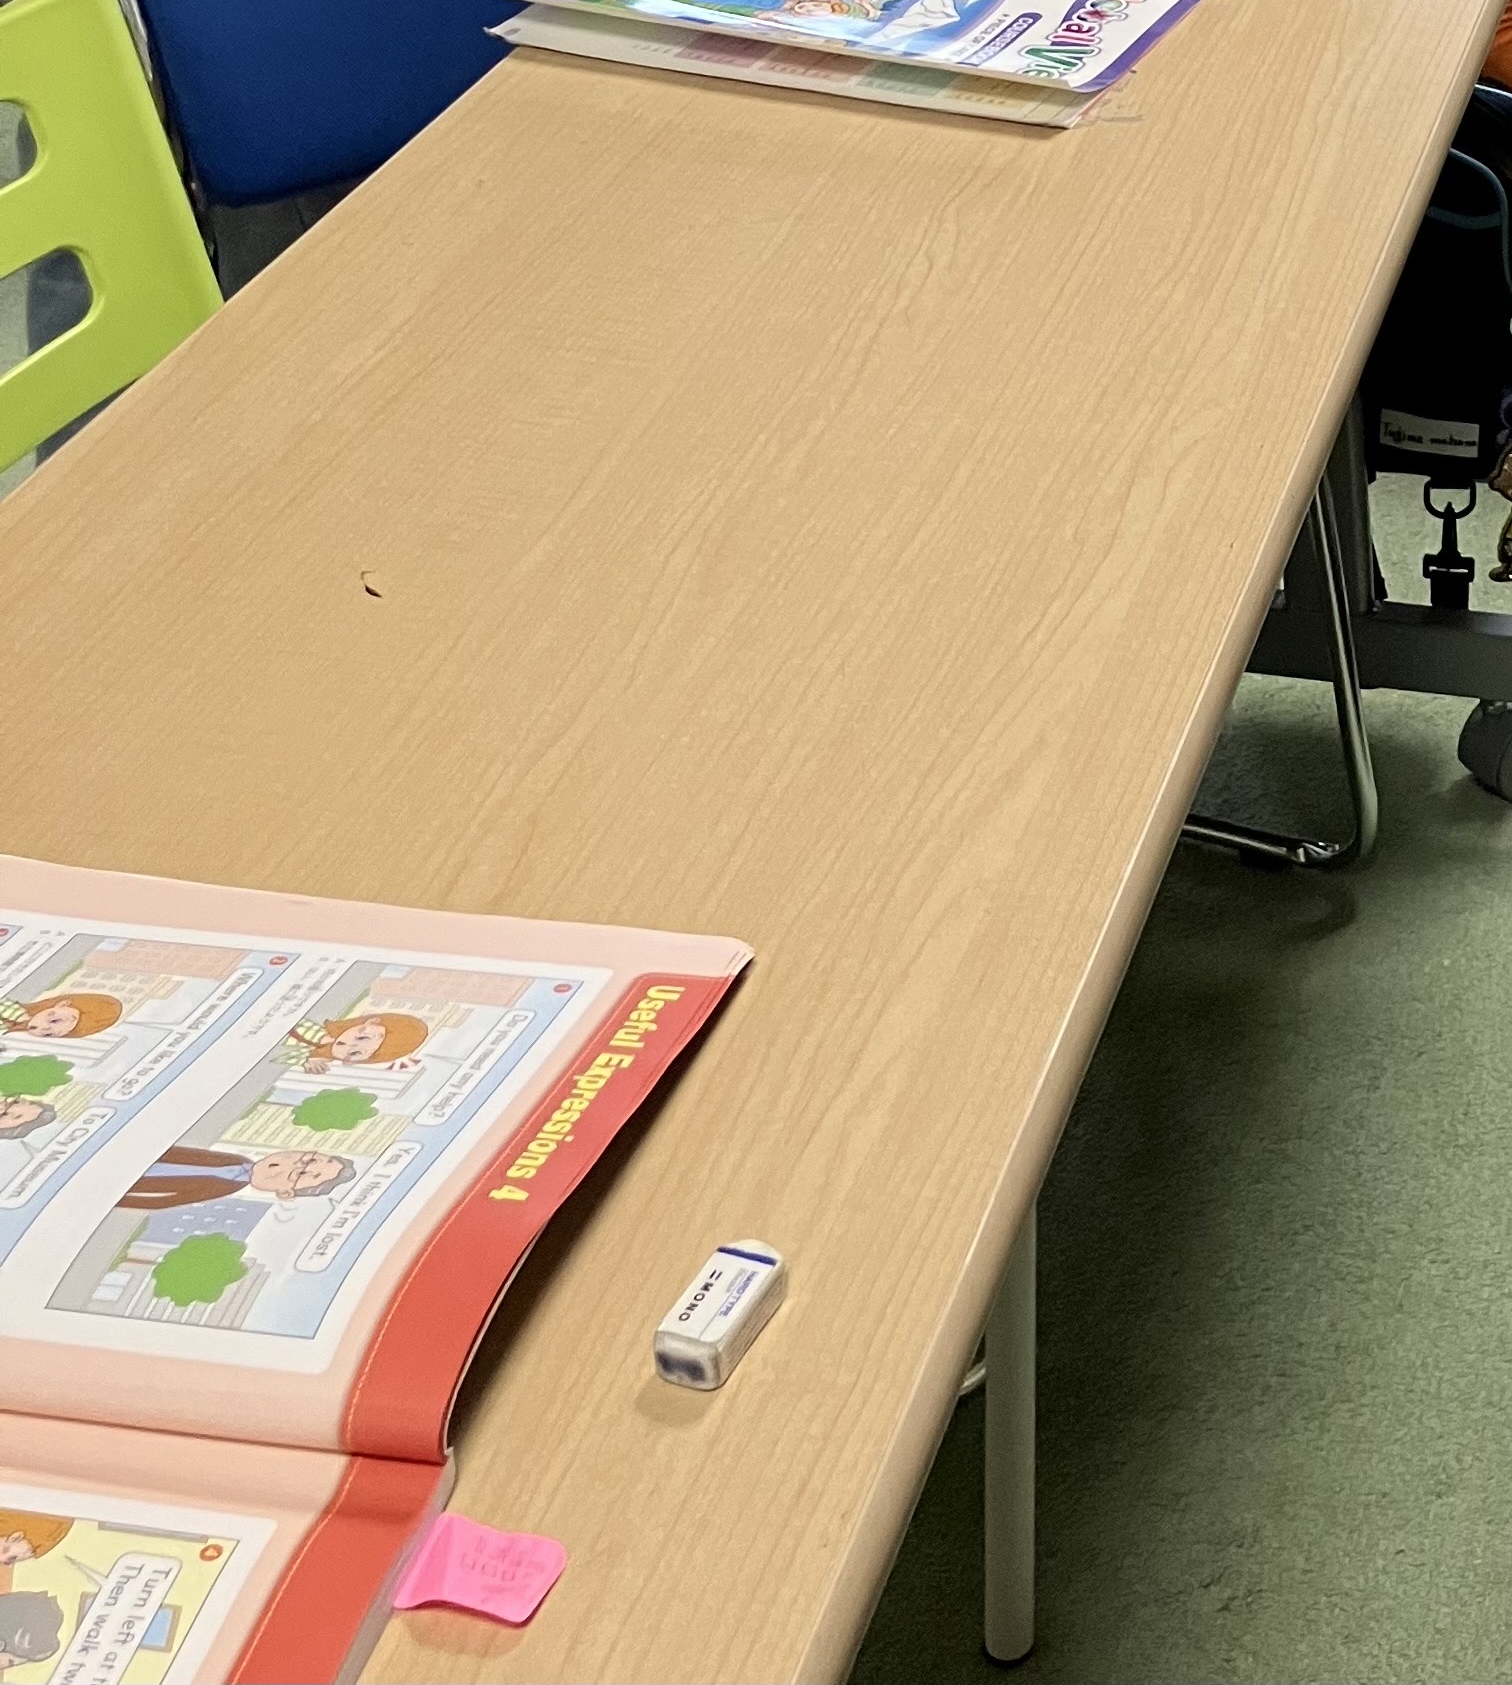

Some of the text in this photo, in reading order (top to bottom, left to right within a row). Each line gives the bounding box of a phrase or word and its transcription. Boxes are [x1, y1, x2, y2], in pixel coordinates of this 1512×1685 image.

[488, 984, 686, 1202] Useful Expressions 4
[82, 1112, 109, 1125] To
[678, 1281, 714, 1322] MONO
[104, 1564, 146, 1607] Then
[133, 1566, 174, 1608] Turn
[77, 1613, 110, 1655] walk
[114, 1615, 145, 1646] left
[100, 1651, 118, 1671] at
